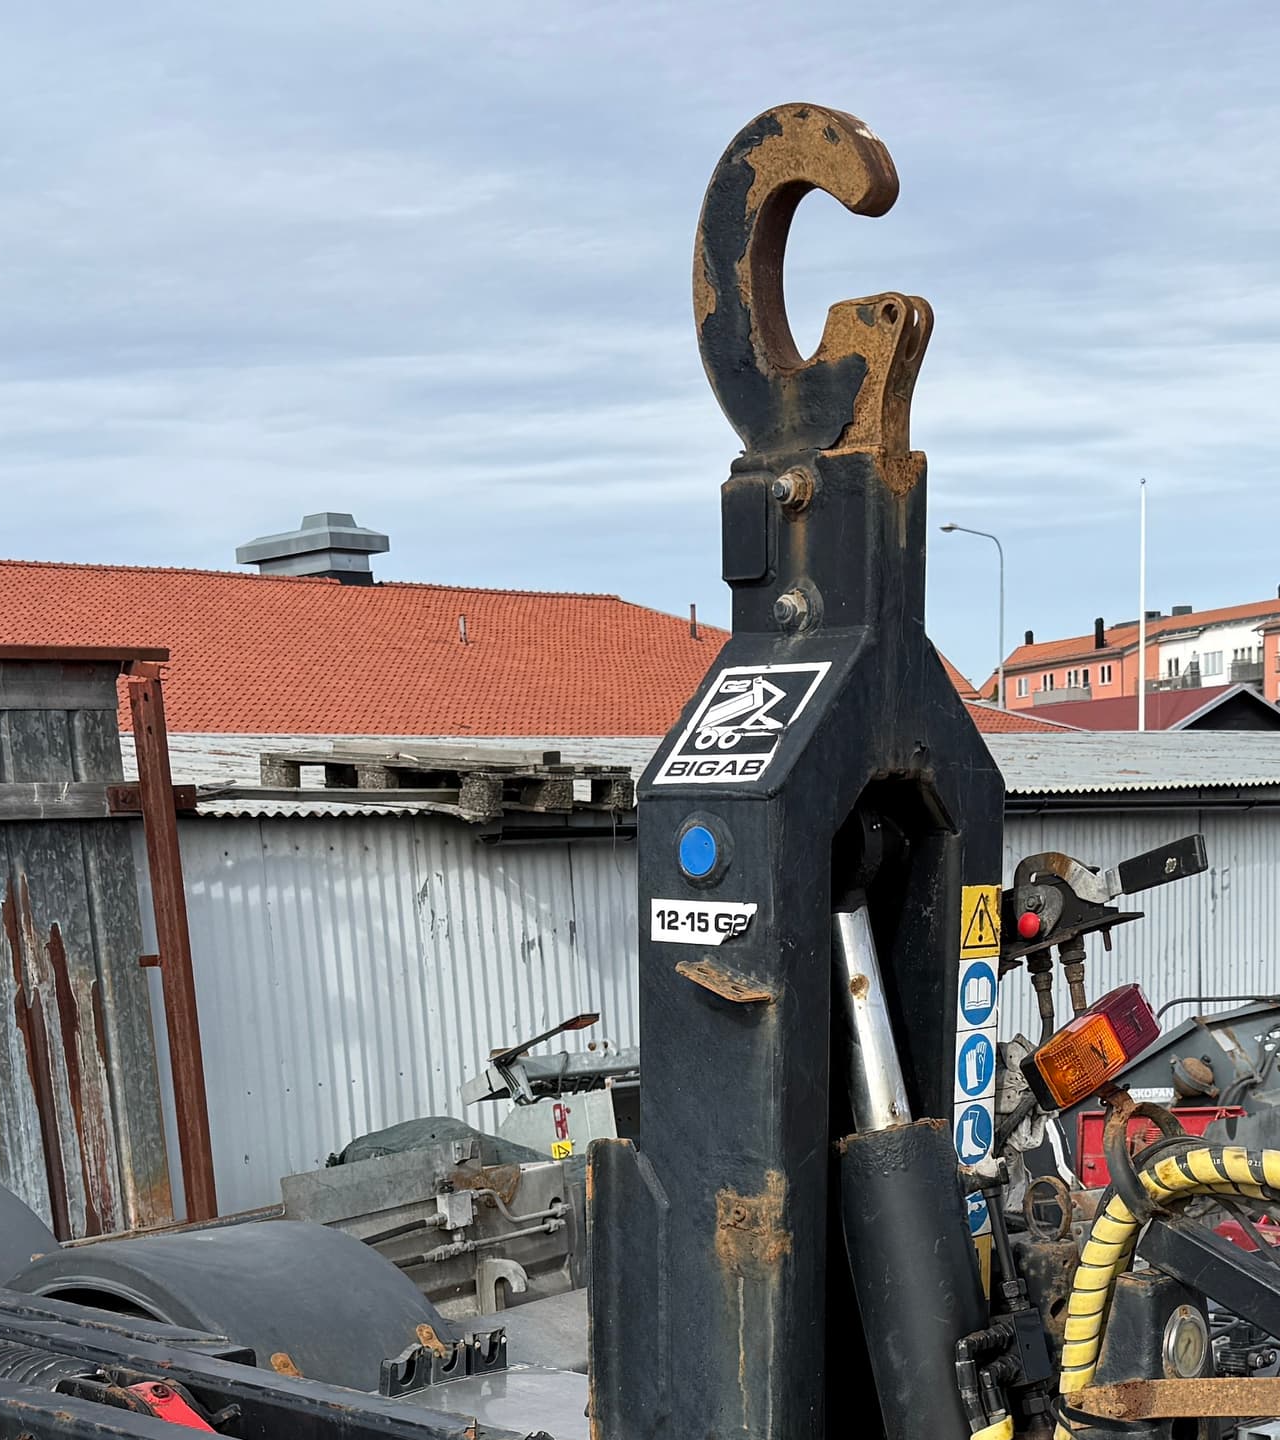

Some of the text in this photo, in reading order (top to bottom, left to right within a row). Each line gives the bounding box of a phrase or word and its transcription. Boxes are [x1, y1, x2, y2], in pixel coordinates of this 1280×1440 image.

[665, 760, 765, 776] BIGAB
[656, 910, 748, 934] 12-15 G2
